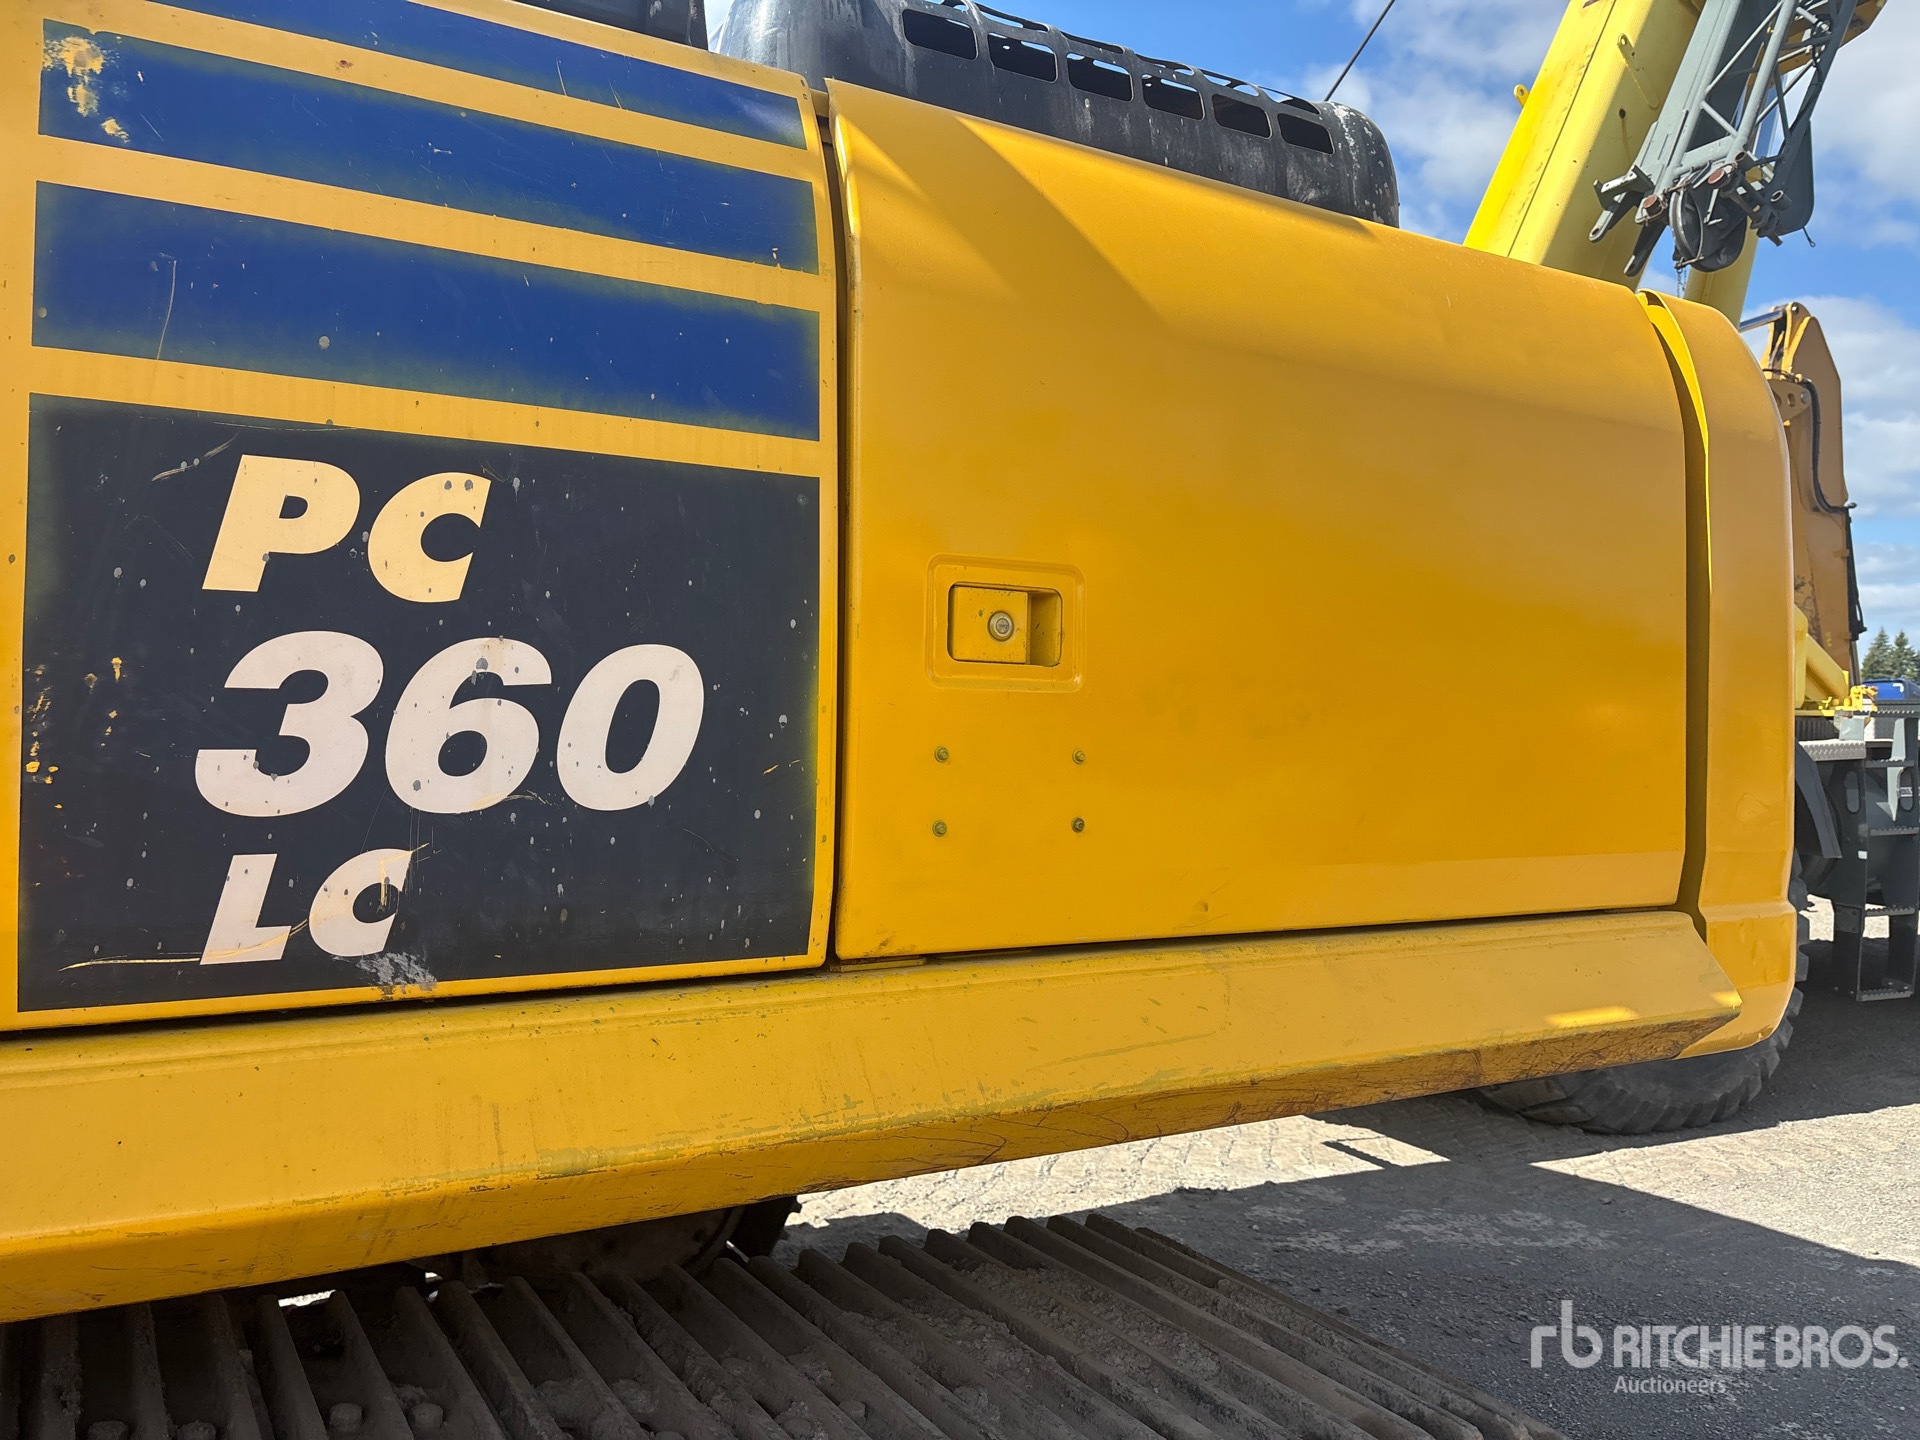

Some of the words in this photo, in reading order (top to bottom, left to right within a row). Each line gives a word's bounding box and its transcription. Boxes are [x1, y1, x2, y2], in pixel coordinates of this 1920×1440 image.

[202, 454, 491, 603] PC
[195, 630, 705, 817] 360
[199, 848, 414, 965] LC
